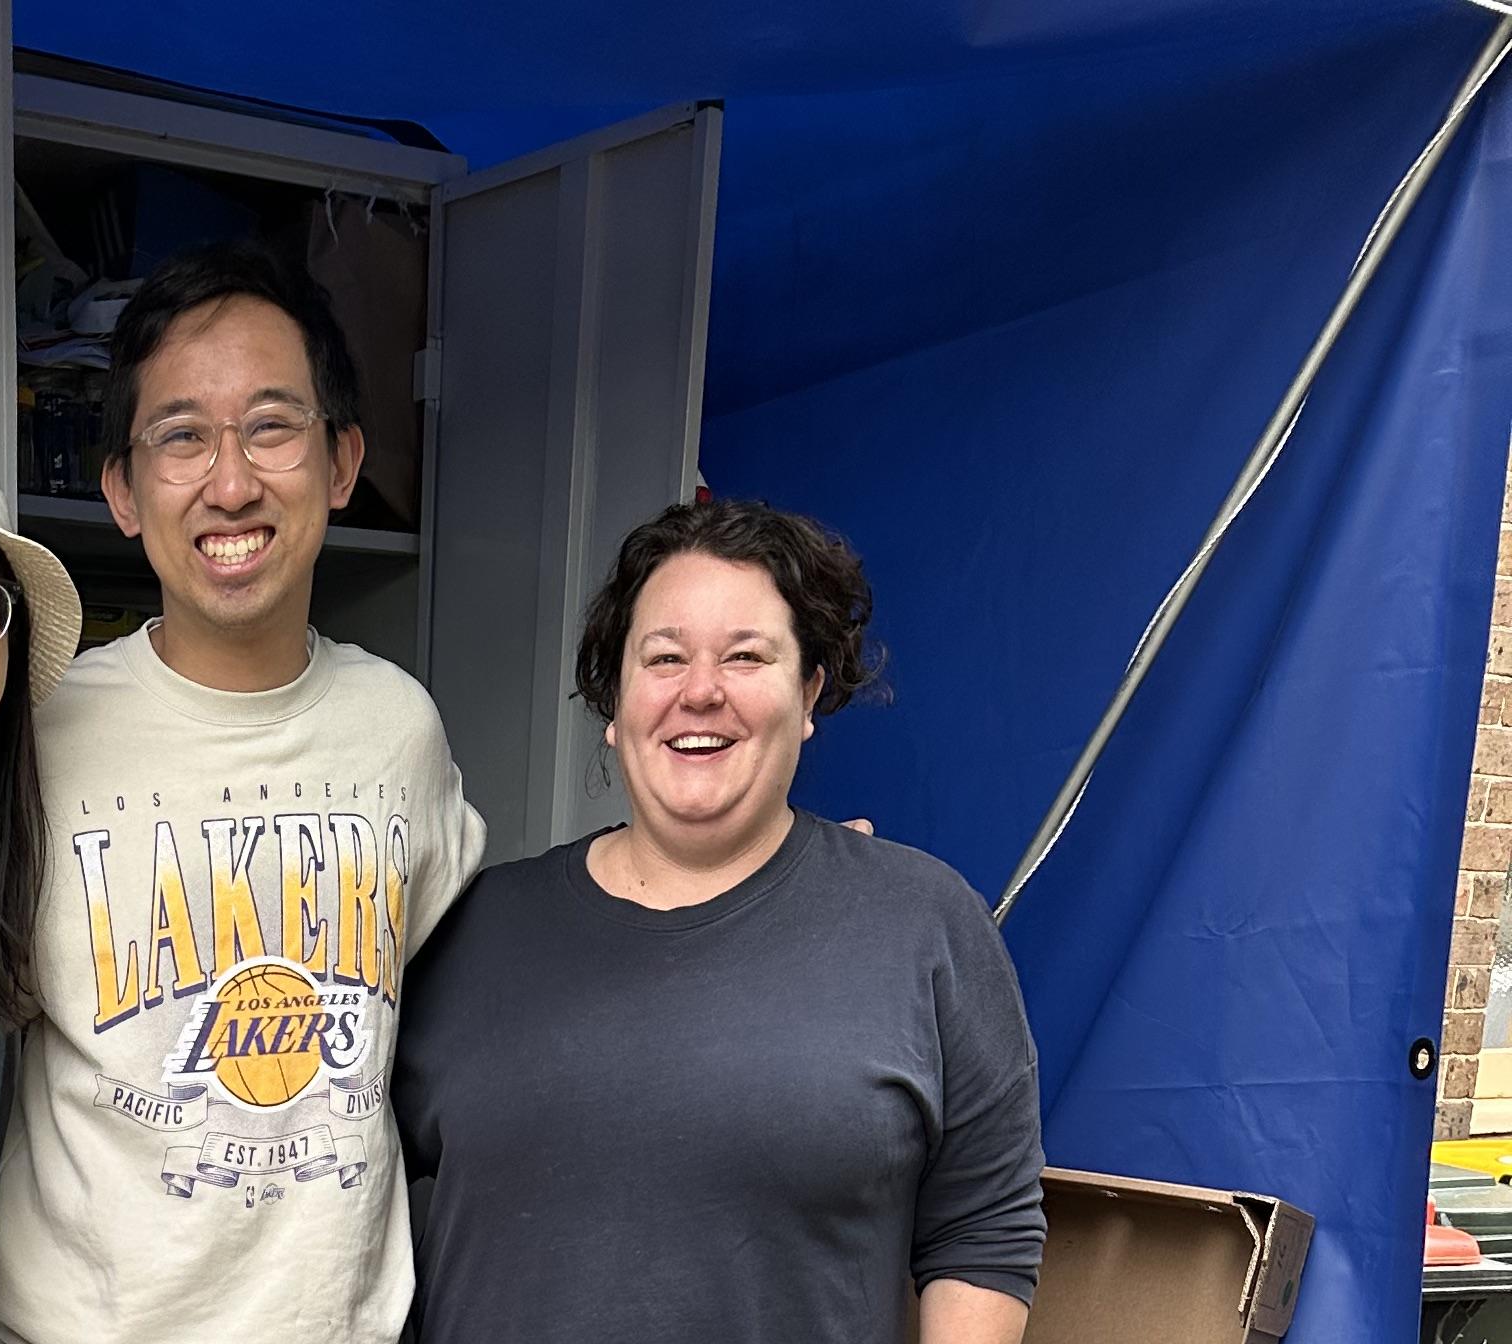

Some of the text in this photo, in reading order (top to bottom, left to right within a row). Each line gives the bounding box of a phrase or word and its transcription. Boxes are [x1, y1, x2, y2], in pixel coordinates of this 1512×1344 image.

[81, 782, 408, 815] LOS ANGELES
[73, 813, 410, 1035] LAKERS
[235, 991, 361, 1012] LOS ANGELES
[173, 1000, 367, 1075] LAKERS
[112, 1087, 184, 1125] PACIFIC
[224, 1136, 310, 1169] EST. 1947
